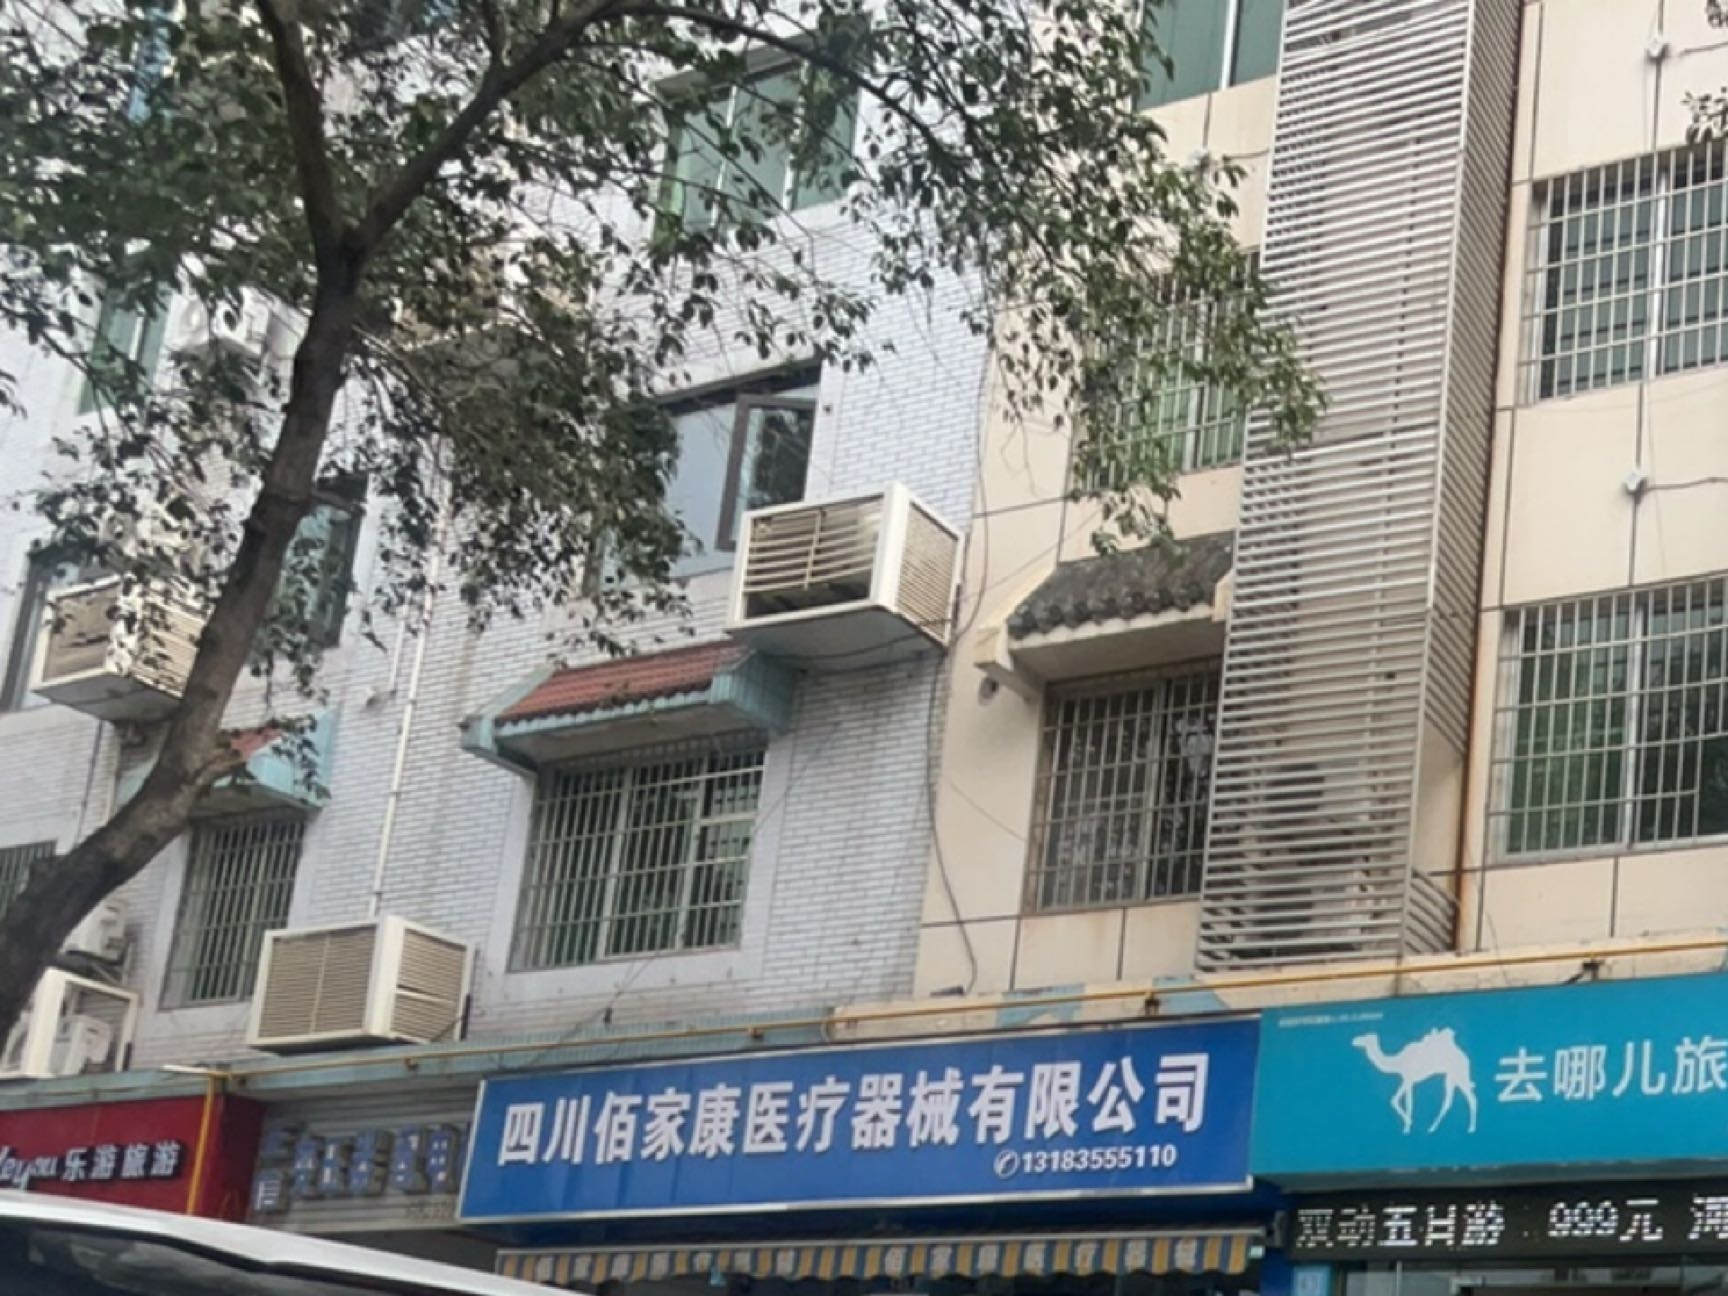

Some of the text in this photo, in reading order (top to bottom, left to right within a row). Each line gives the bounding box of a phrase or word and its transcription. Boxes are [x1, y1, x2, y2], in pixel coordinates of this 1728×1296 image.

[496, 1052, 1211, 1167] 四川佰家康医疗器械有限公司
[1023, 1144, 1177, 1174] 13183555110
